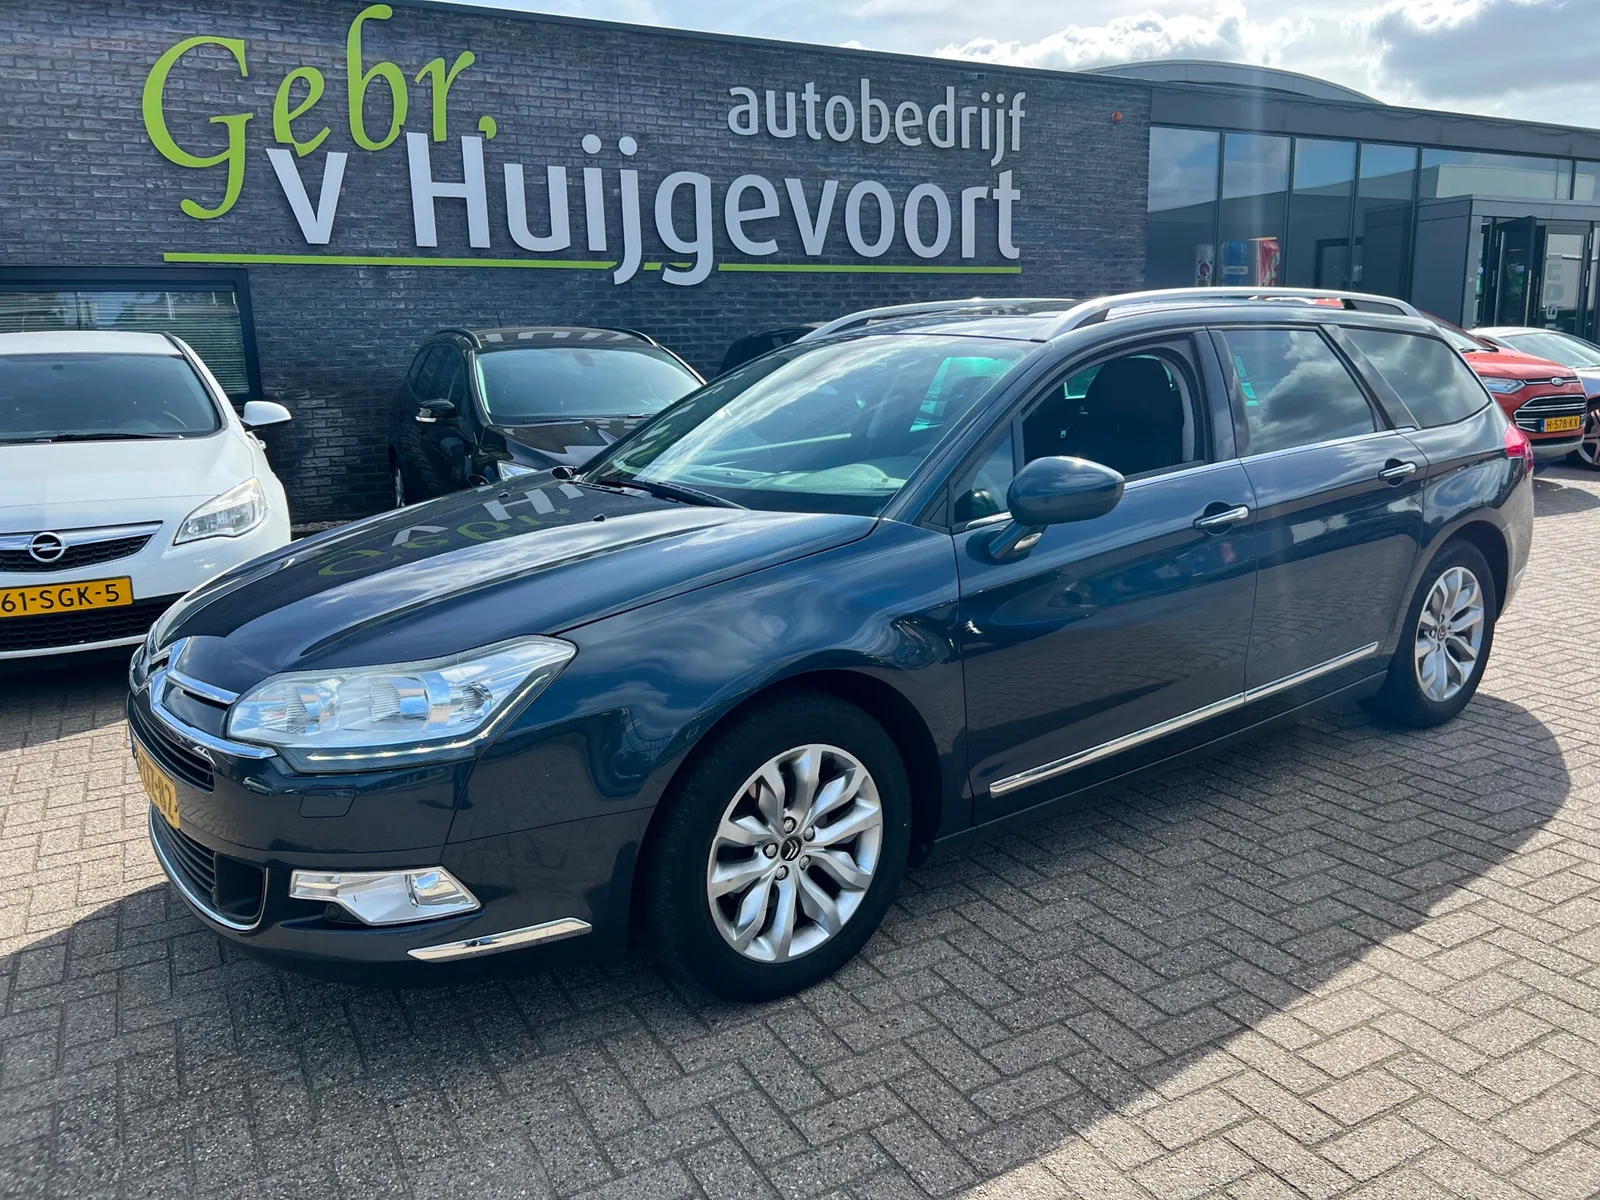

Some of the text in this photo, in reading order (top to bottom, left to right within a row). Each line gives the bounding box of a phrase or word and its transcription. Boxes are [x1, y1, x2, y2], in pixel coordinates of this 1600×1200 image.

[142, 4, 497, 219] Gebr.
[727, 78, 1025, 167] autobedrijf
[266, 131, 1021, 286] v Huijgevoort
[1, 583, 120, 613] 61-SGK-5
